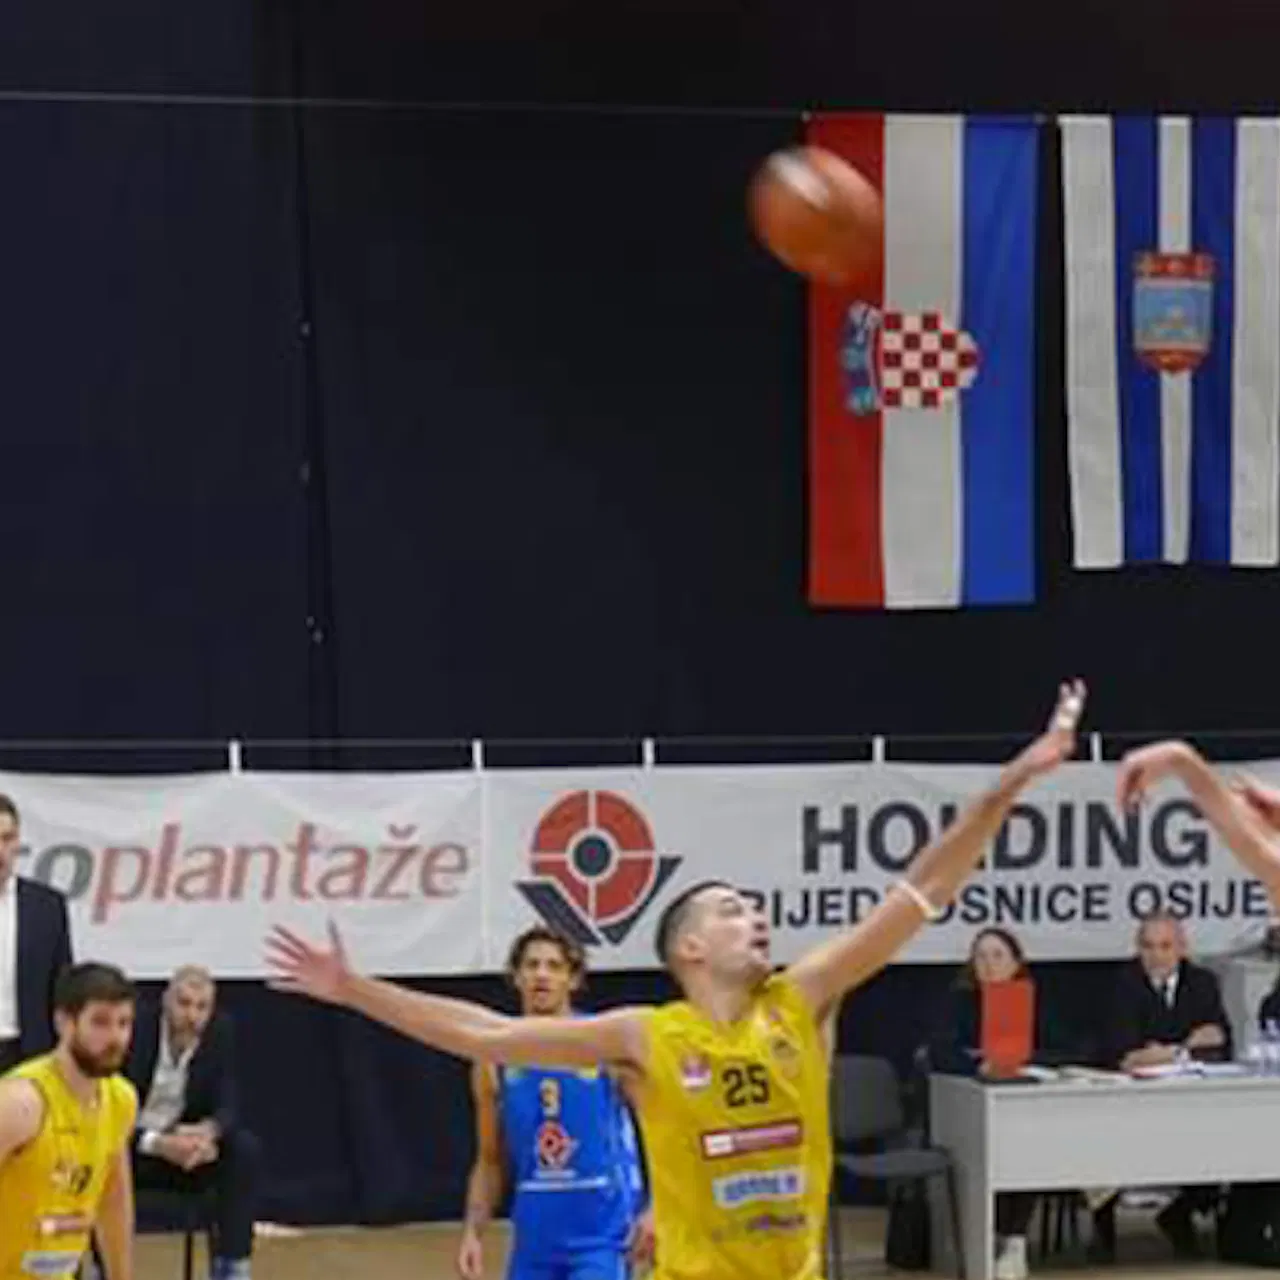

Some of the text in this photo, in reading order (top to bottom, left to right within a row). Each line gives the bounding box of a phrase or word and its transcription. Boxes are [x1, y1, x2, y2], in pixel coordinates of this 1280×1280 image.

[1127, 880, 1269, 921] OSIJE
[539, 1076, 561, 1117] 3
[722, 1063, 769, 1108] 25
